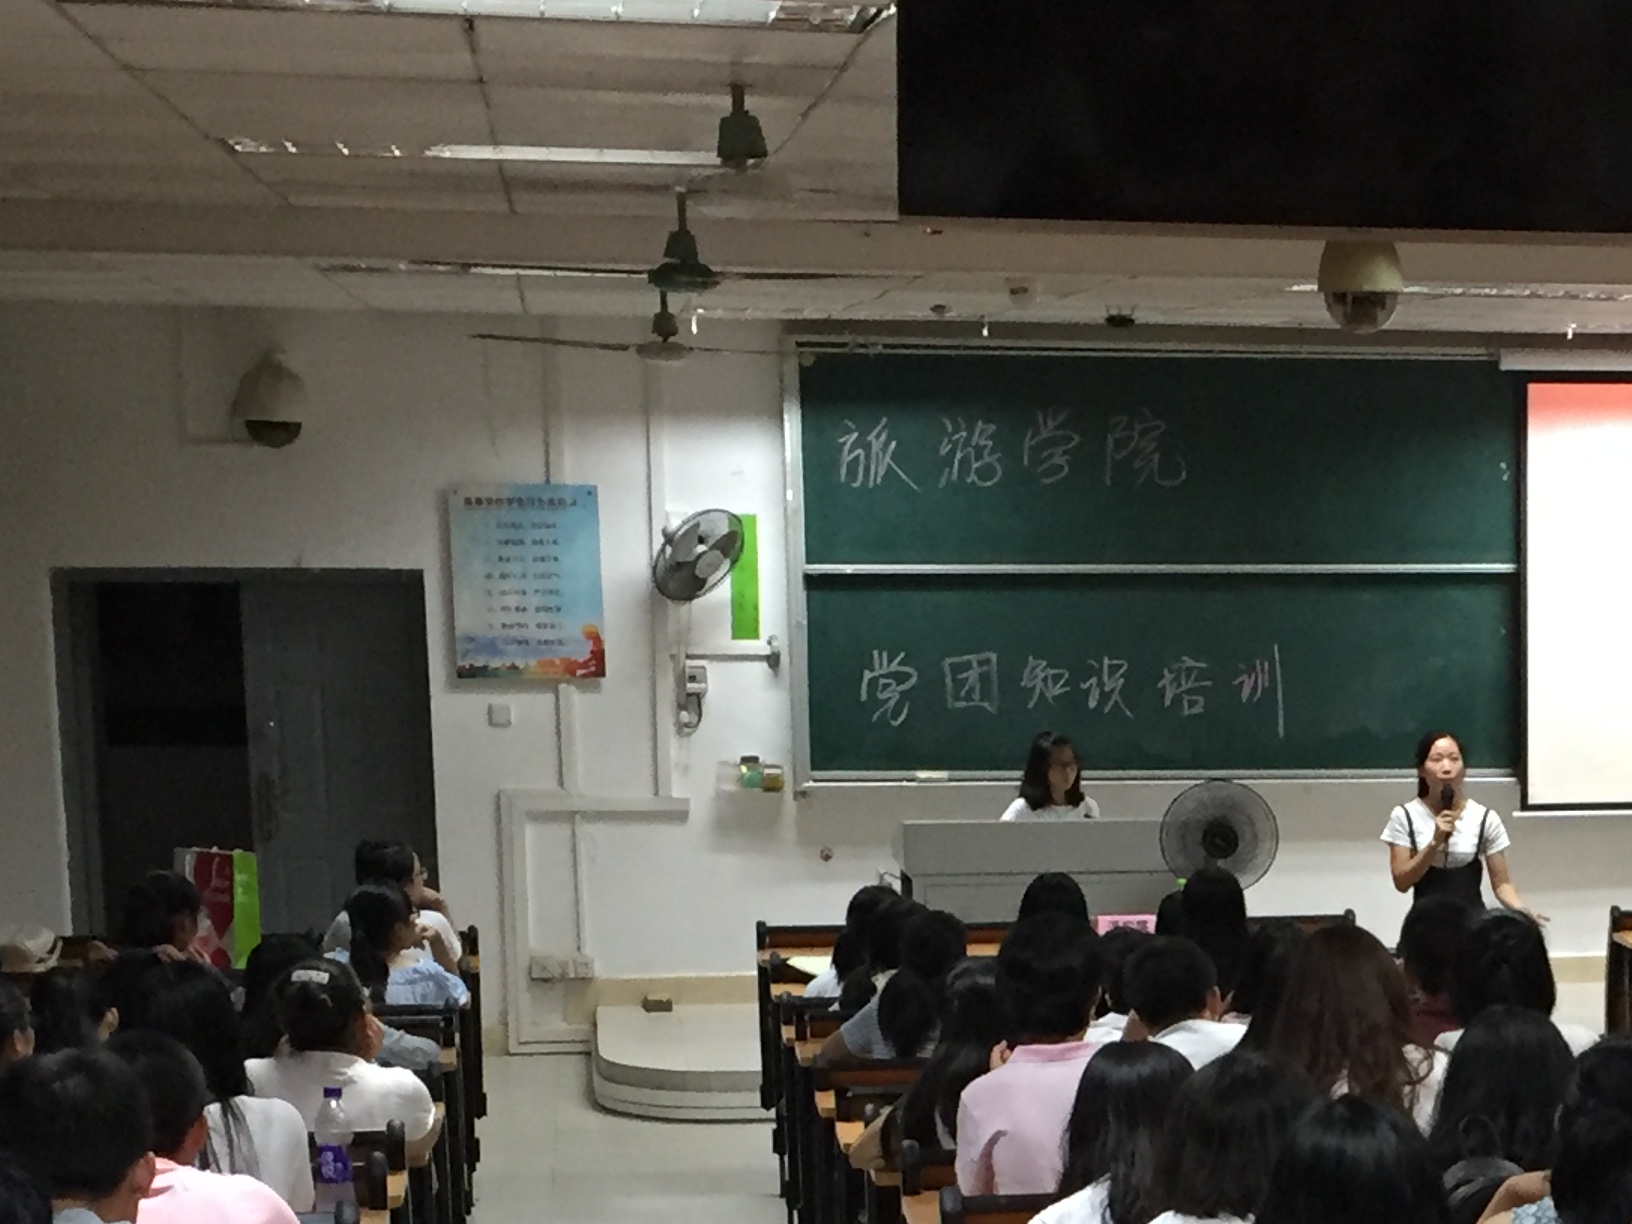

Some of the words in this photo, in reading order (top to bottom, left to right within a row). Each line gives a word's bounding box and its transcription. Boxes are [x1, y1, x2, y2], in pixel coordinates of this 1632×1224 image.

[838, 407, 1188, 493] 旅游学院
[859, 643, 1286, 740] 党团知识培训
